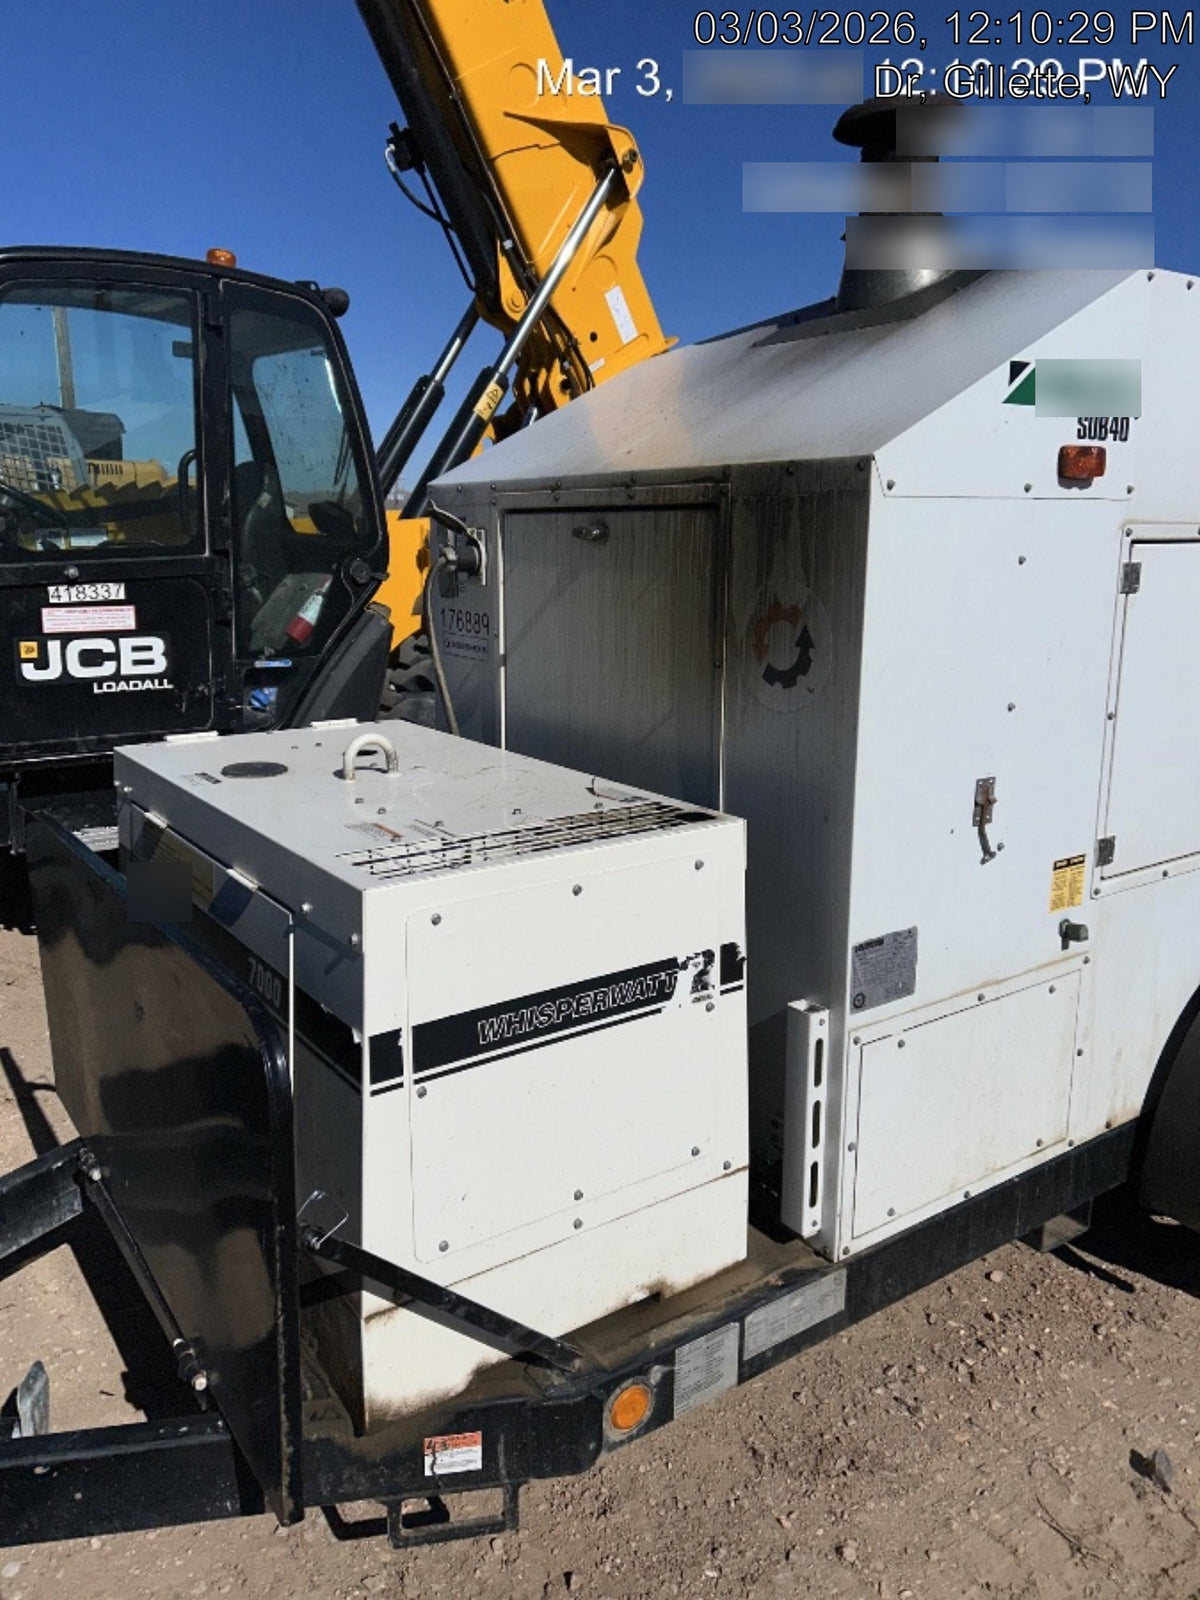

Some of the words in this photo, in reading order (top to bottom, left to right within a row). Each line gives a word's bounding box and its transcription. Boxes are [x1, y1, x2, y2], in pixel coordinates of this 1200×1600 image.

[50, 583, 125, 602] 418337
[440, 607, 490, 636] 176889
[20, 635, 168, 682] JCB
[93, 678, 174, 694] LOADALL
[477, 969, 679, 1045] WHISPERWATT
